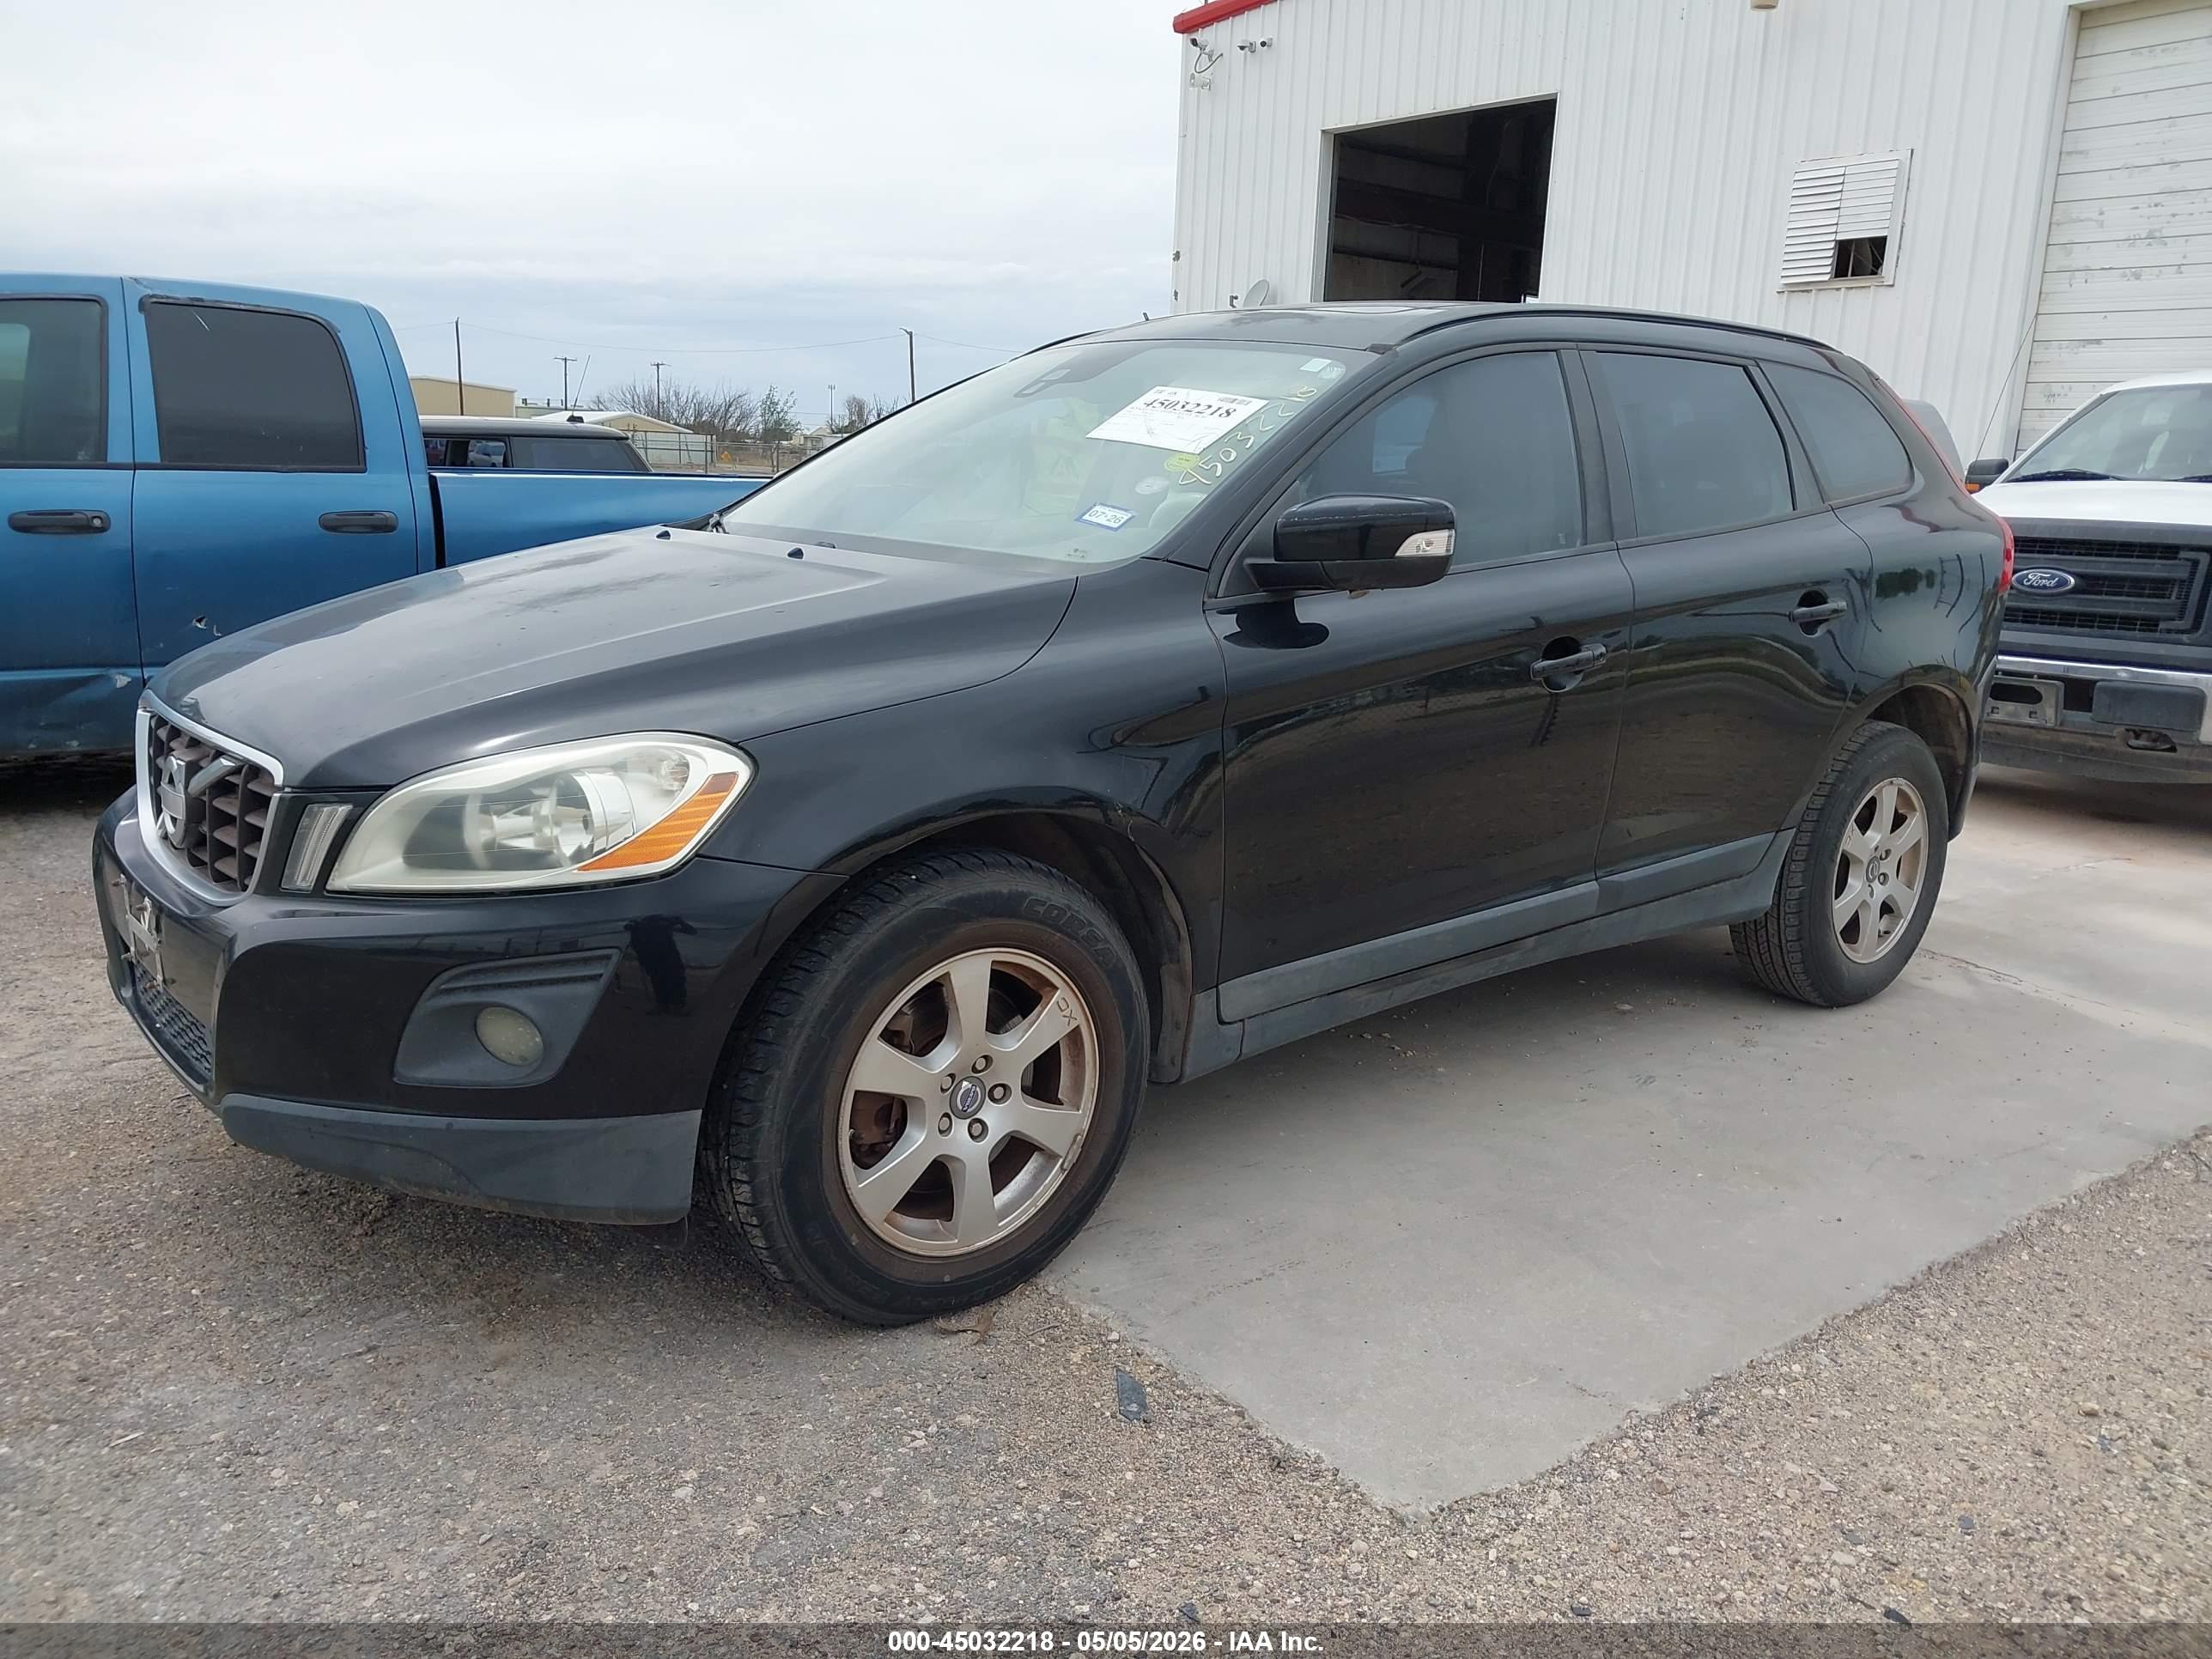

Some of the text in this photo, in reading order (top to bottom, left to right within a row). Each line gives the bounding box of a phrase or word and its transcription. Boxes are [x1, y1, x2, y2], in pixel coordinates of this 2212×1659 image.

[1143, 398, 1237, 418] 45032218
[1088, 509, 1106, 519] 07
[1106, 514, 1124, 524] 26
[2023, 572, 2058, 587] Ford
